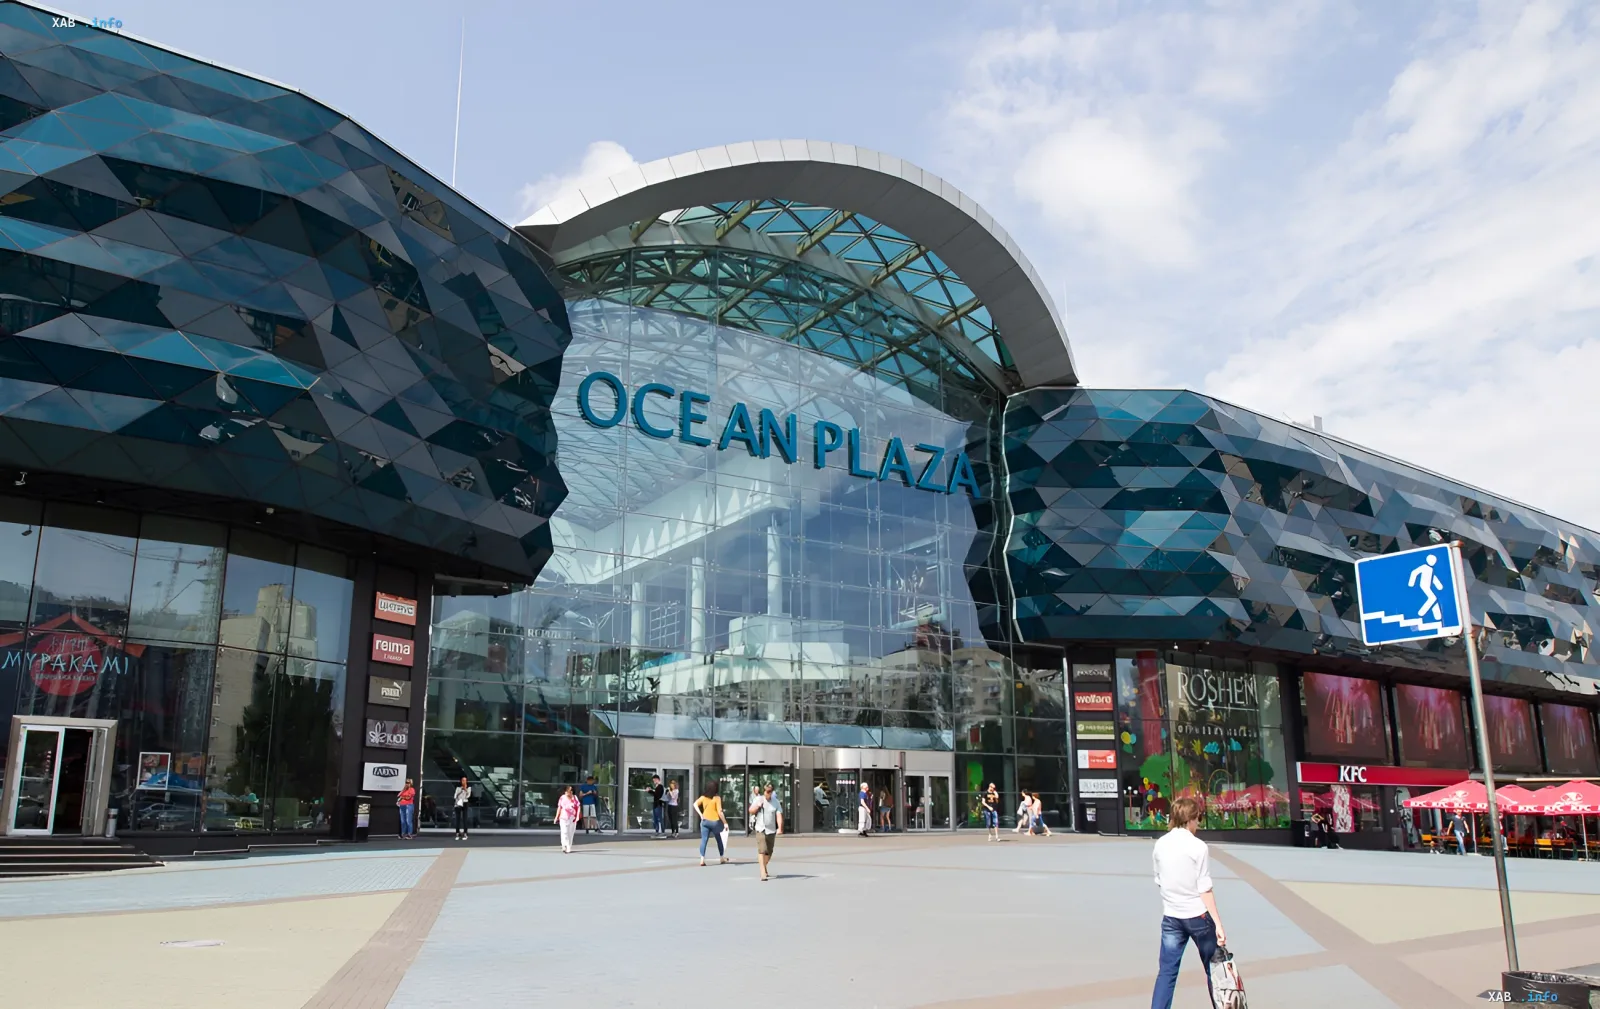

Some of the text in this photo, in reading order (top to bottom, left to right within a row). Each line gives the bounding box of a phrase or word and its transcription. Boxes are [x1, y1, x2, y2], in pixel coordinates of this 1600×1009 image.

[577, 371, 981, 499] OCEAN PLAZA
[1177, 671, 1259, 707] ROSHEN
[1339, 765, 1367, 783] KFC
